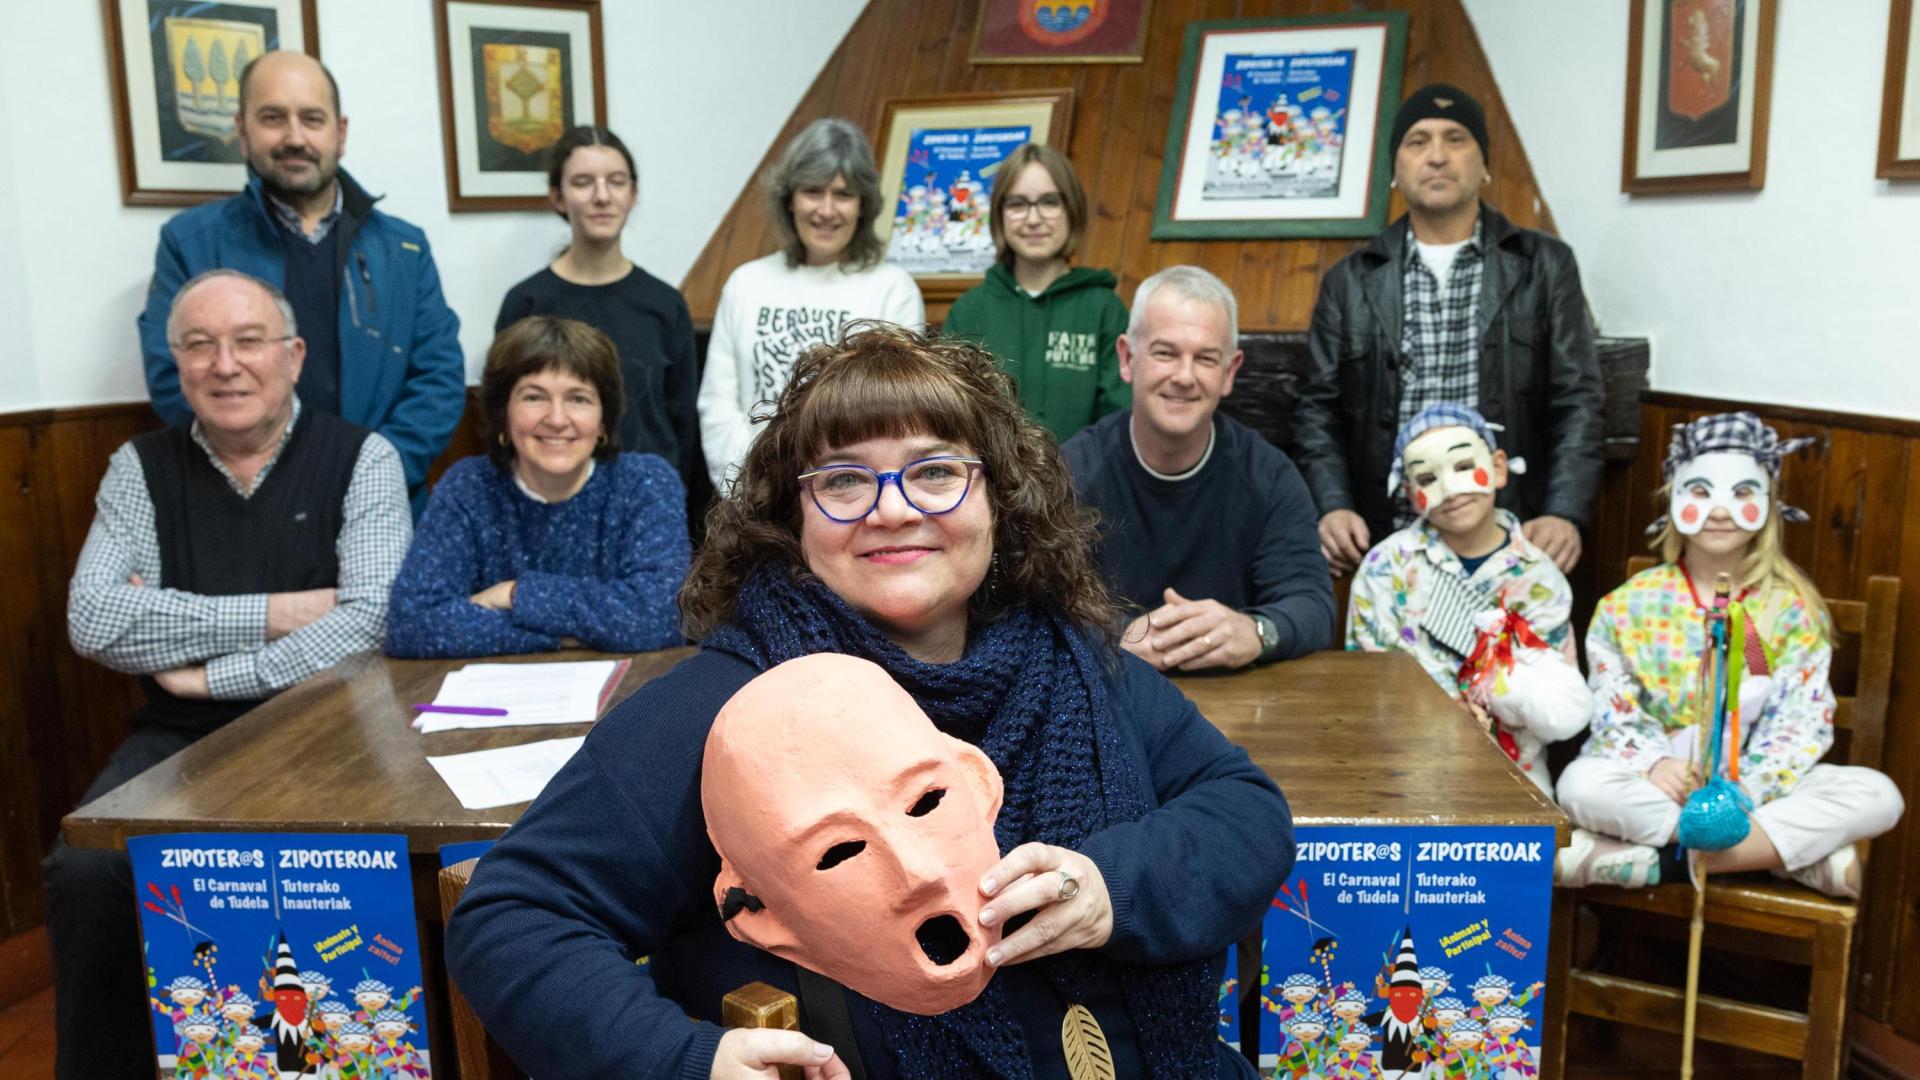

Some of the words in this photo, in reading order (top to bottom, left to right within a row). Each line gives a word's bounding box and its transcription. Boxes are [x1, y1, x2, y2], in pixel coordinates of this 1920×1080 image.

[161, 848, 265, 869] ZIPOTER@S
[1295, 841, 1402, 862] ZIPOTER@S
[1416, 841, 1542, 862] ZIPOTEROAK
[278, 849, 398, 870] ZIPOTEROAK
[193, 878, 206, 892] El
[207, 878, 267, 892] Carnaval
[281, 879, 340, 893] Tuterako
[1323, 872, 1336, 887] El
[1338, 872, 1401, 887] Carnaval
[1415, 872, 1477, 887] Tuterako
[209, 895, 225, 909] de
[227, 895, 269, 909] Tudela
[282, 896, 352, 910] Inauteriak
[1337, 890, 1353, 904] de
[1356, 890, 1400, 904] Tudela
[1414, 890, 1486, 904] Inauteriak
